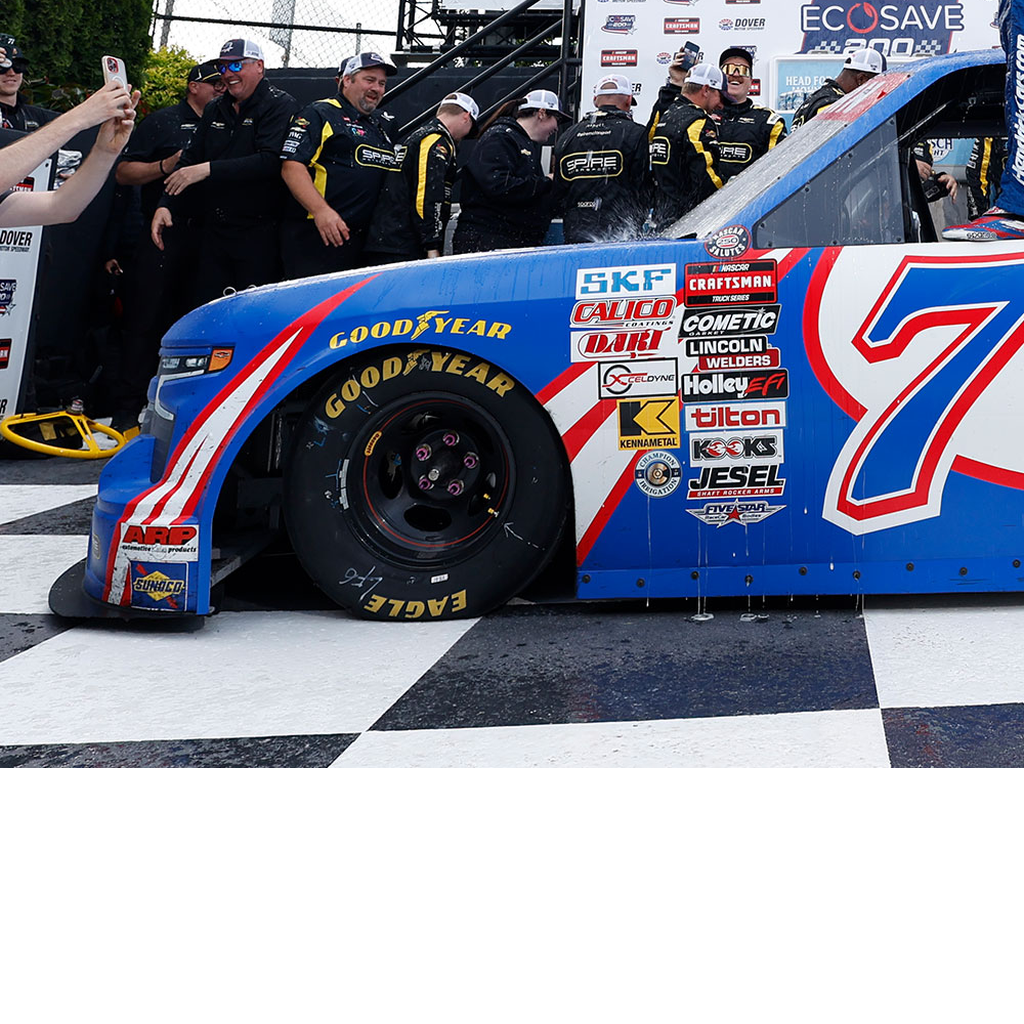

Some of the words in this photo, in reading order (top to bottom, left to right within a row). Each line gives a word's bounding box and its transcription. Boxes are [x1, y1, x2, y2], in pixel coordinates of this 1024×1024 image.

[734, 18, 766, 27] DOVER
[803, 5, 962, 31] ECOSAVE
[786, 76, 811, 86] HEAD
[566, 156, 617, 171] SPIRE
[712, 227, 745, 241] NASCAR
[709, 243, 746, 257] SALUTES
[721, 264, 750, 272] NASCAR
[580, 269, 672, 295] SKF
[689, 275, 772, 291] CRAFTSMAN
[712, 295, 730, 303] TRUCK
[730, 294, 750, 302] SERIES
[574, 298, 674, 324] CALICO
[625, 320, 674, 328] COATINGS
[683, 310, 776, 333] COMETIC
[584, 327, 671, 355] DART
[690, 339, 763, 355] LINCOLN
[706, 355, 771, 369] WELDERS
[684, 373, 750, 399] Holley
[745, 372, 786, 396] EFI
[691, 407, 781, 428] tilton
[620, 438, 678, 449] KENNAMETAL
[692, 436, 778, 461] KOOKS
[640, 452, 676, 468] CHAMPION
[690, 465, 783, 489] JESEL
[639, 478, 678, 495] IRRIGATION
[705, 505, 735, 514] FIVE
[737, 503, 766, 512] STAR
[122, 525, 197, 546] ARP
[135, 578, 183, 593] SUNOCO
[363, 589, 467, 619] EAGLE
